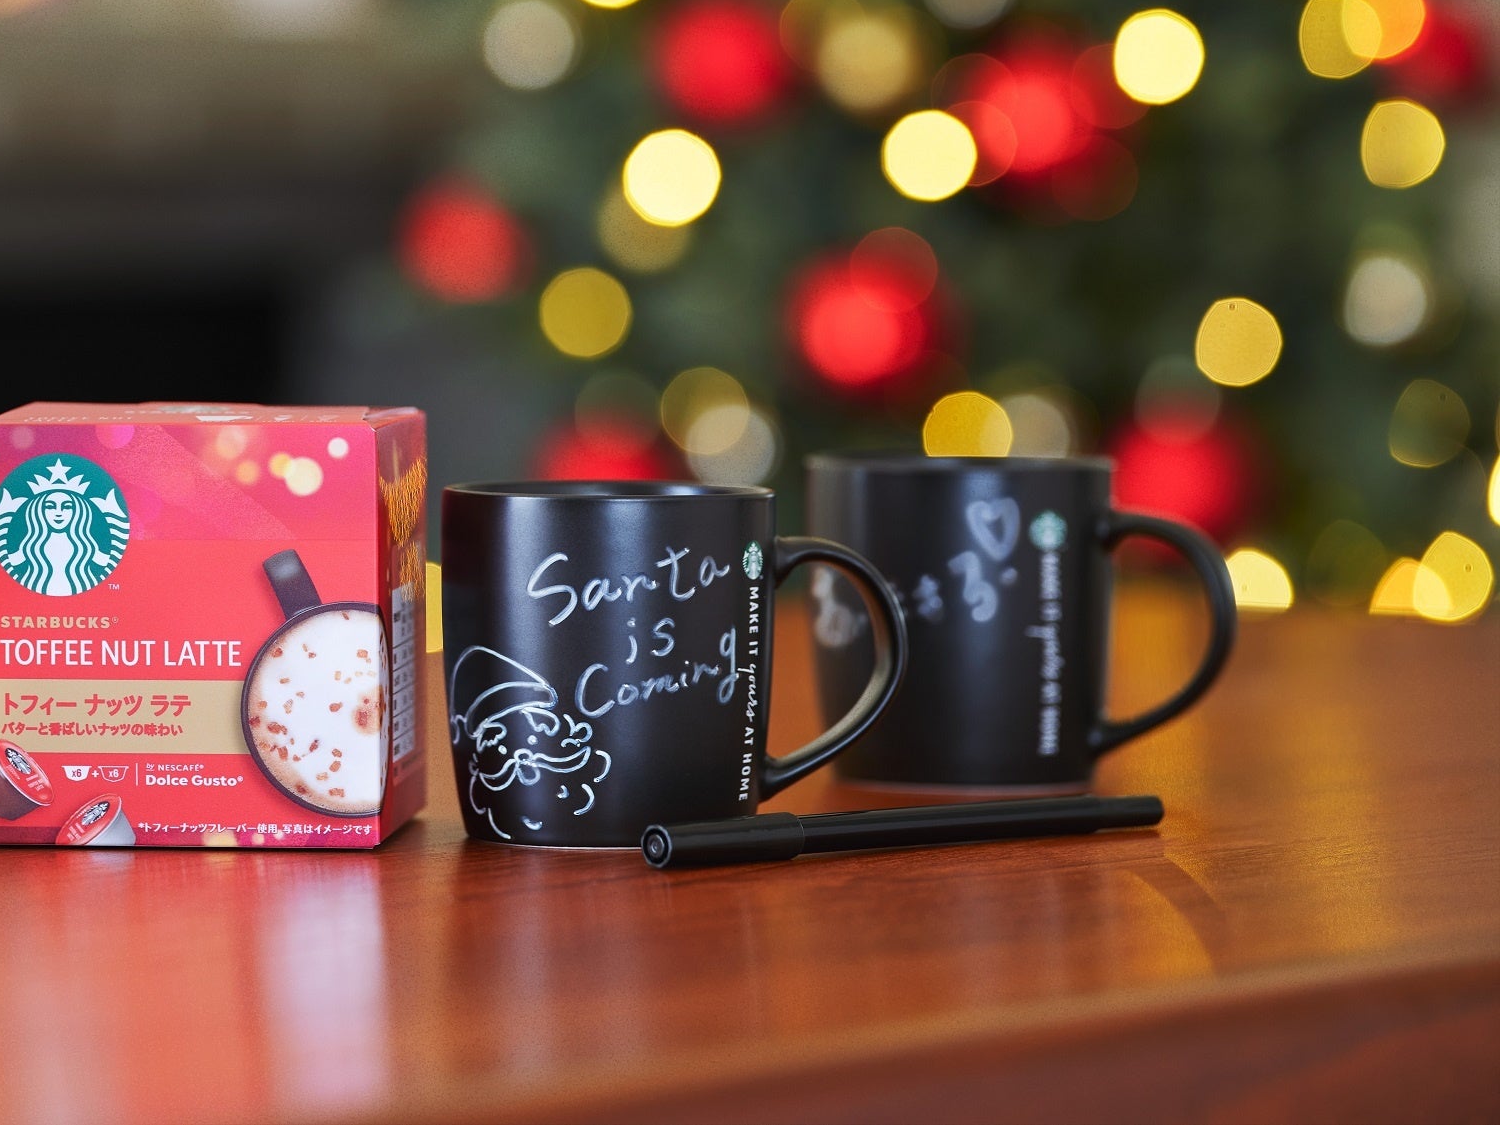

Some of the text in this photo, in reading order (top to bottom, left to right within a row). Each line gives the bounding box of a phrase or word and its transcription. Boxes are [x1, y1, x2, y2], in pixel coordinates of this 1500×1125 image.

[527, 546, 730, 626] Santa
[0, 639, 242, 666] TOFFEE NUT LATTE
[625, 617, 675, 664] is
[575, 624, 740, 719] Coming
[737, 586, 759, 801] MAKE IT yours AT HOME
[4, 692, 192, 717] トフィー ナッツ ラテ
[145, 775, 188, 786] Dolce
